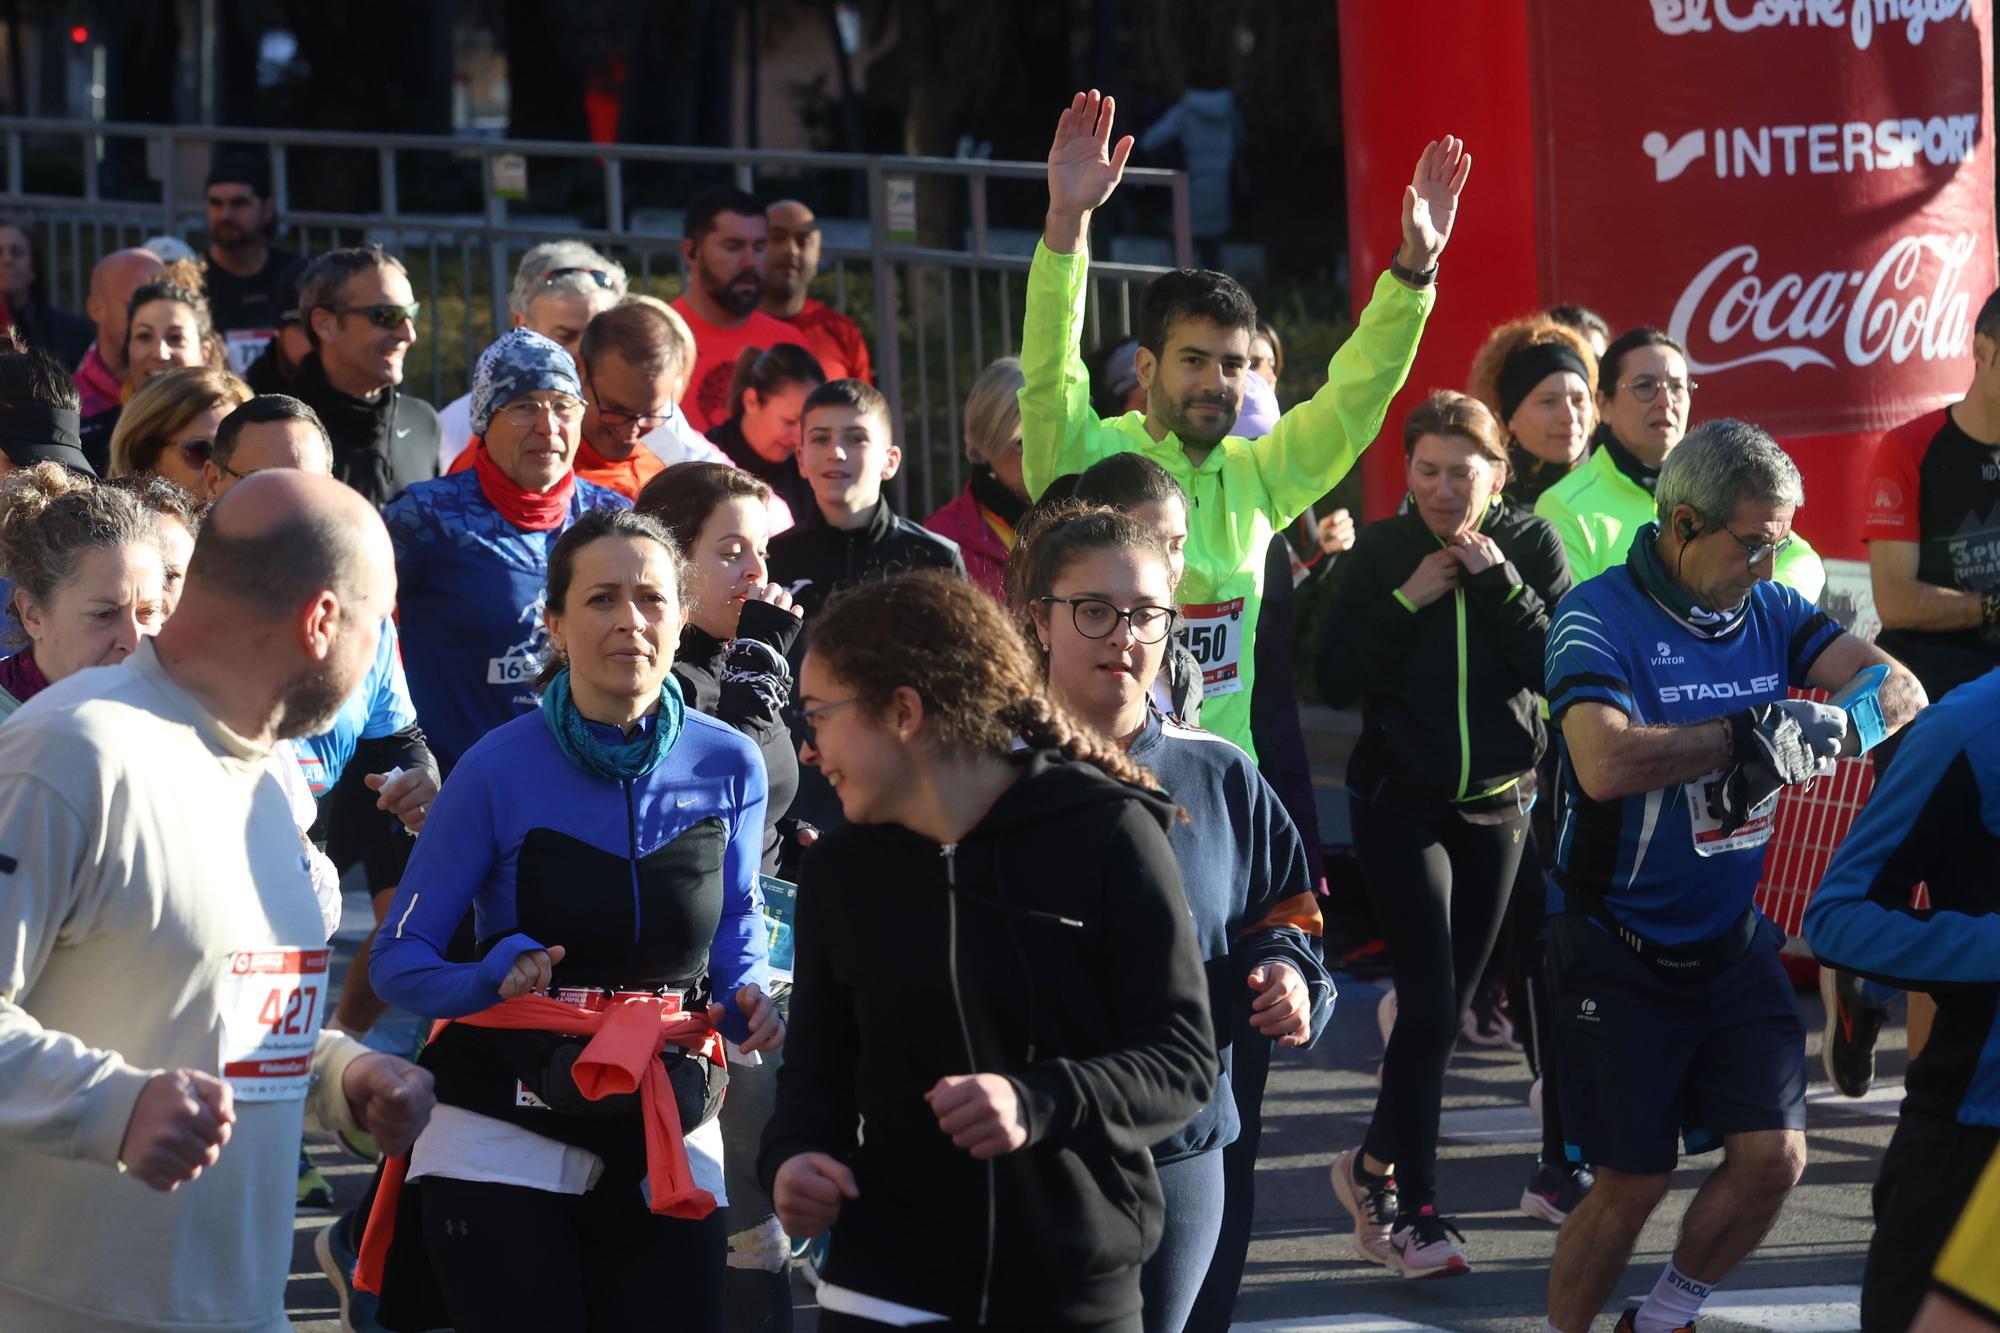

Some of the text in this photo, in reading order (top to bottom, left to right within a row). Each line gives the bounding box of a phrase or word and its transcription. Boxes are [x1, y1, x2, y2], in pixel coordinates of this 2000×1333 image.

[1714, 113, 1978, 178] INTERSPORT
[1667, 231, 1977, 375] Coca-Cola
[497, 661, 521, 680] 16
[1651, 656, 1685, 666] VIATOR
[257, 985, 318, 1036] 427
